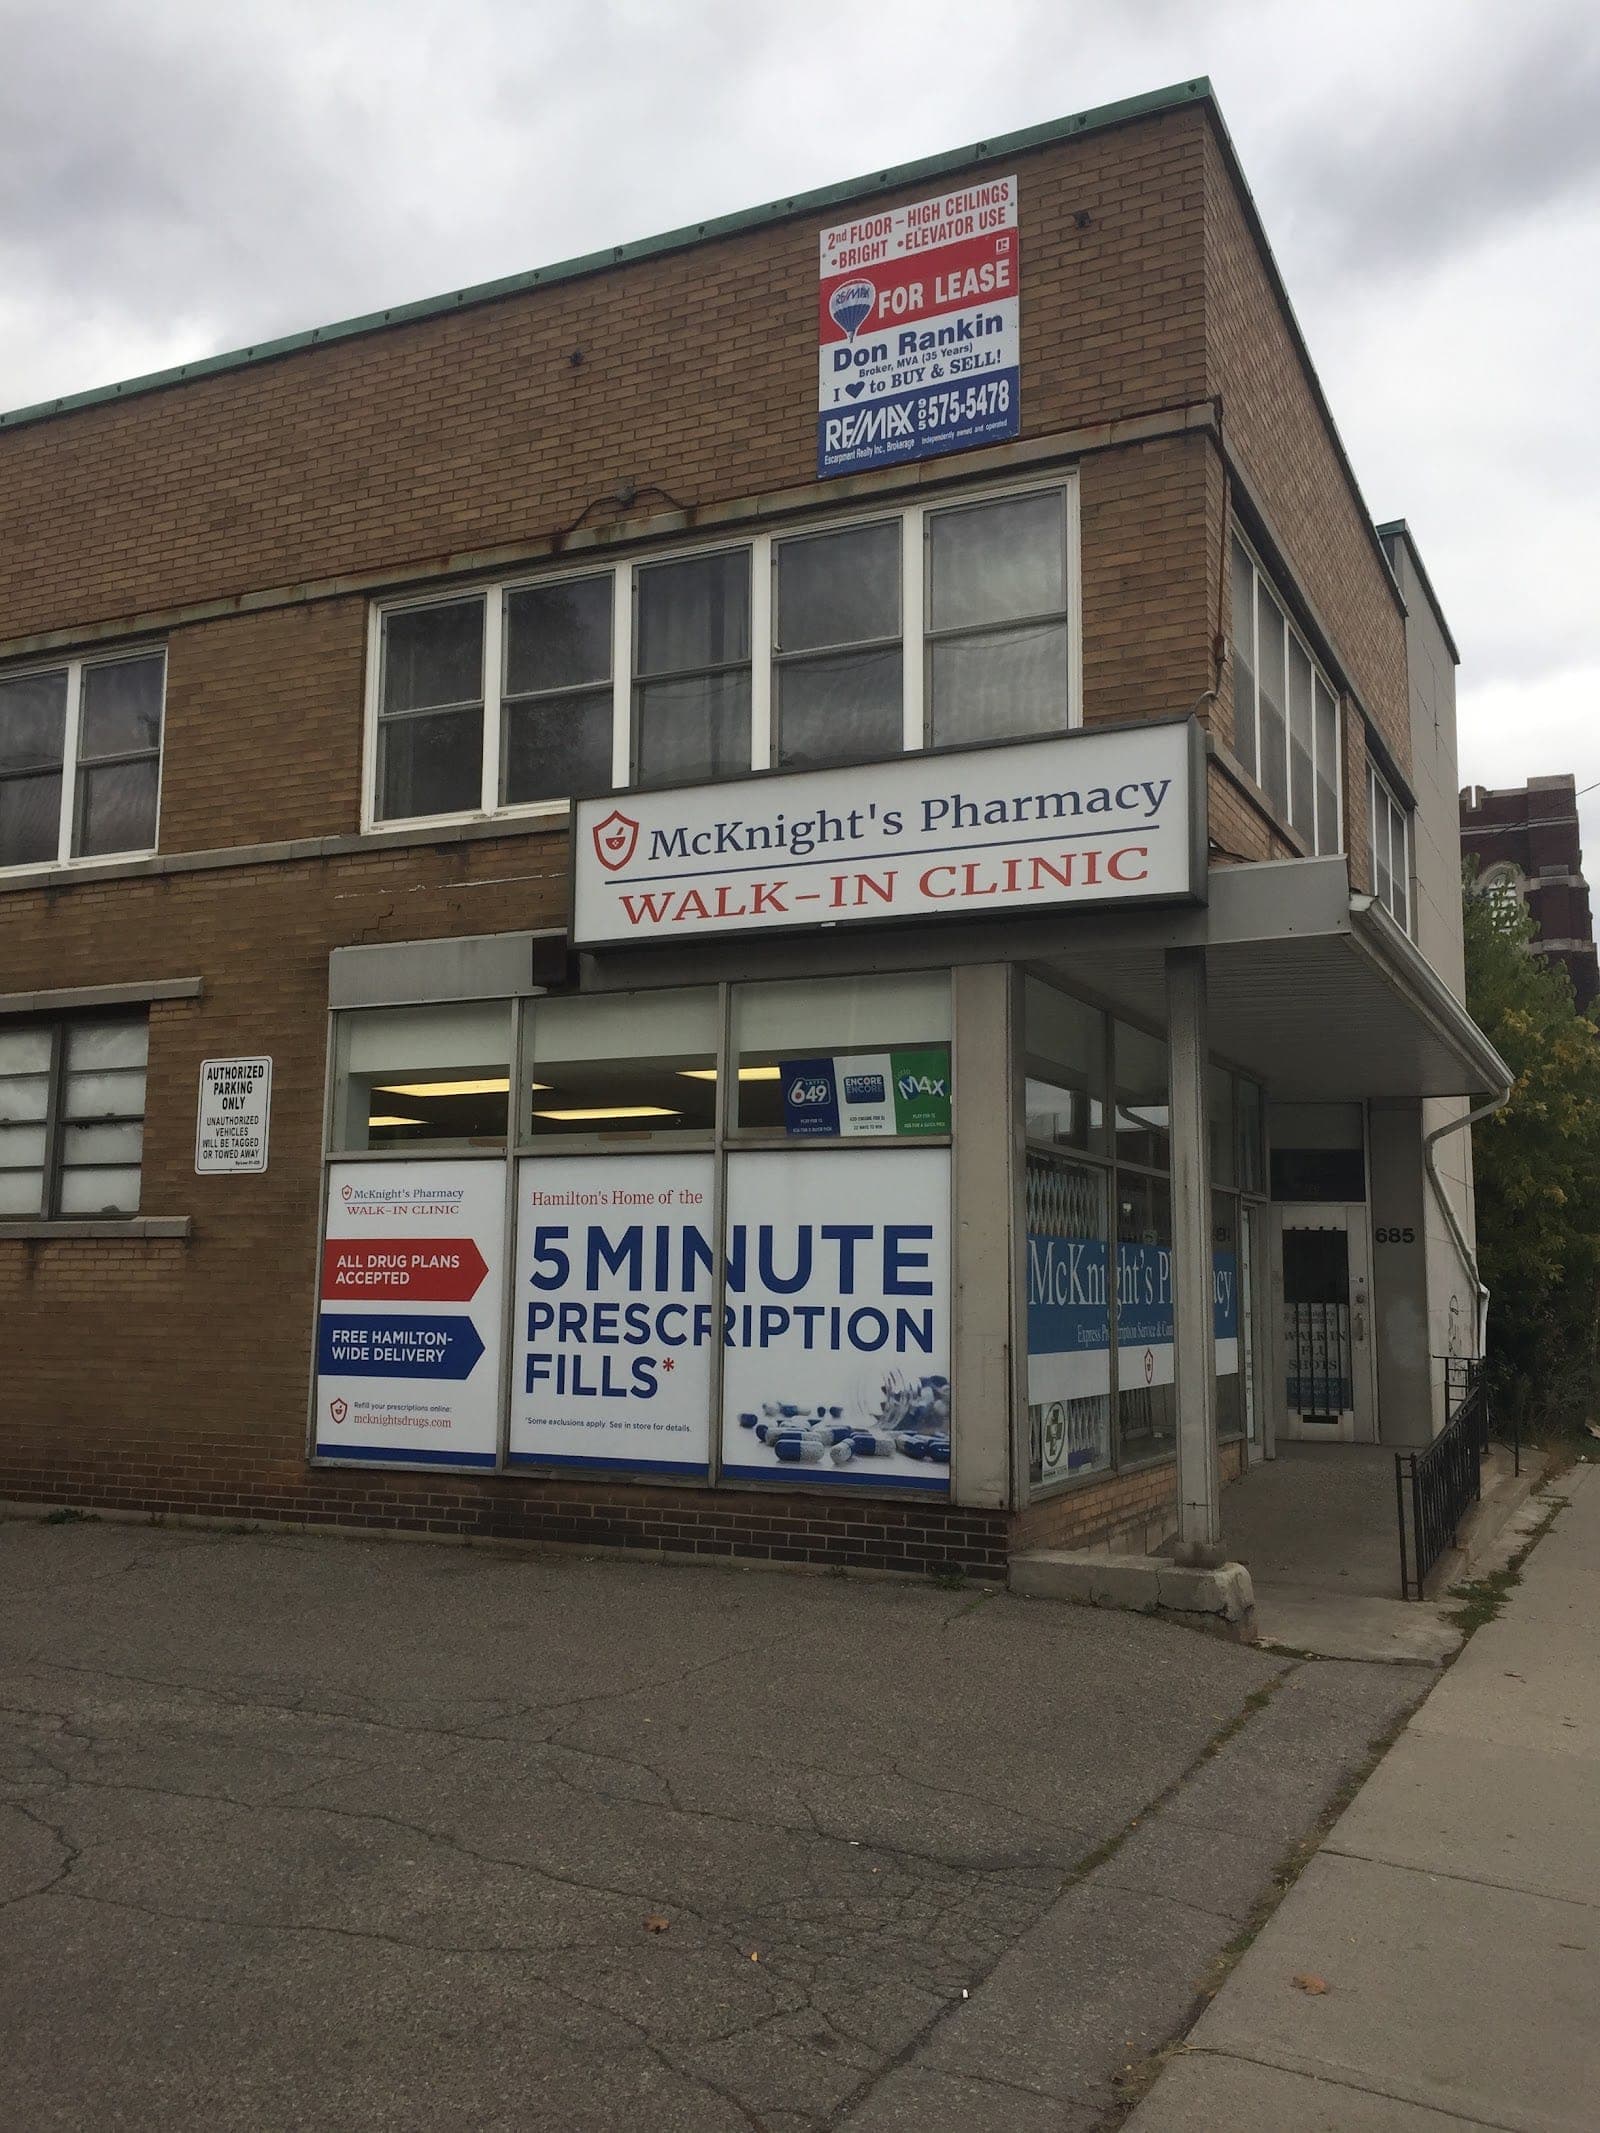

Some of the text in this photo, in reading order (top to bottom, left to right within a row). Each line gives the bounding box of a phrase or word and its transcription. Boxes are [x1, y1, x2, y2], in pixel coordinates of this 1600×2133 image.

[828, 228, 847, 250] 2nd
[850, 216, 892, 244] FLOOR
[907, 202, 940, 228] HIGH
[945, 182, 1009, 216] CEILINGS
[839, 239, 888, 268] BRIGHT
[905, 216, 973, 250] ELEVATOR
[979, 206, 1006, 230] USE
[878, 259, 1010, 319] FOR LEASE
[833, 313, 1003, 372] Don Rankin
[859, 342, 973, 378] Broker, MVA (35 Years)
[833, 349, 1002, 402] I to BUY & SELL!
[928, 379, 1010, 428] 575-5478
[825, 399, 915, 452] RE/MAX
[824, 451, 855, 466] Escarpment
[856, 447, 873, 459] Realty
[886, 438, 915, 452] Brokerage
[647, 777, 1172, 861] McKnight's Pharmacy
[918, 846, 1150, 898] CLINIC
[207, 1065, 264, 1080] AUTHORIZED
[213, 1081, 253, 1095] PARKING
[845, 1076, 882, 1086] ENCORE
[898, 1075, 945, 1100] MAX
[222, 1096, 246, 1110] ONLY
[206, 1115, 259, 1126] UNAUTHORIZED
[215, 1127, 249, 1137] VEHICLES
[202, 1137, 259, 1148] WILL BE TAGGED
[203, 1148, 260, 1159] OR TOWED AWAY
[354, 1189, 464, 1200] McKnight's Pharmacy
[532, 1189, 703, 1207] Hamilton's Home of the
[412, 1205, 459, 1214] CLINIC
[1374, 1227, 1415, 1244] 685
[337, 1255, 460, 1268] ALL DRUG PLANS
[529, 1224, 934, 1296] 5 MINUTE
[335, 1271, 410, 1285] ACCEPTED
[527, 1302, 934, 1353] PRESCRIPTION
[332, 1330, 453, 1345] FREE HAMILTON-
[331, 1347, 445, 1362] WIDE DELIVERY
[354, 1401, 370, 1409] Refill
[386, 1403, 428, 1412] prescriptions
[354, 1413, 451, 1429] mcknightsdrugs.com
[548, 1418, 584, 1427] exclusions
[609, 1421, 622, 1429] See
[633, 1422, 651, 1430] store
[653, 1422, 663, 1430] for
